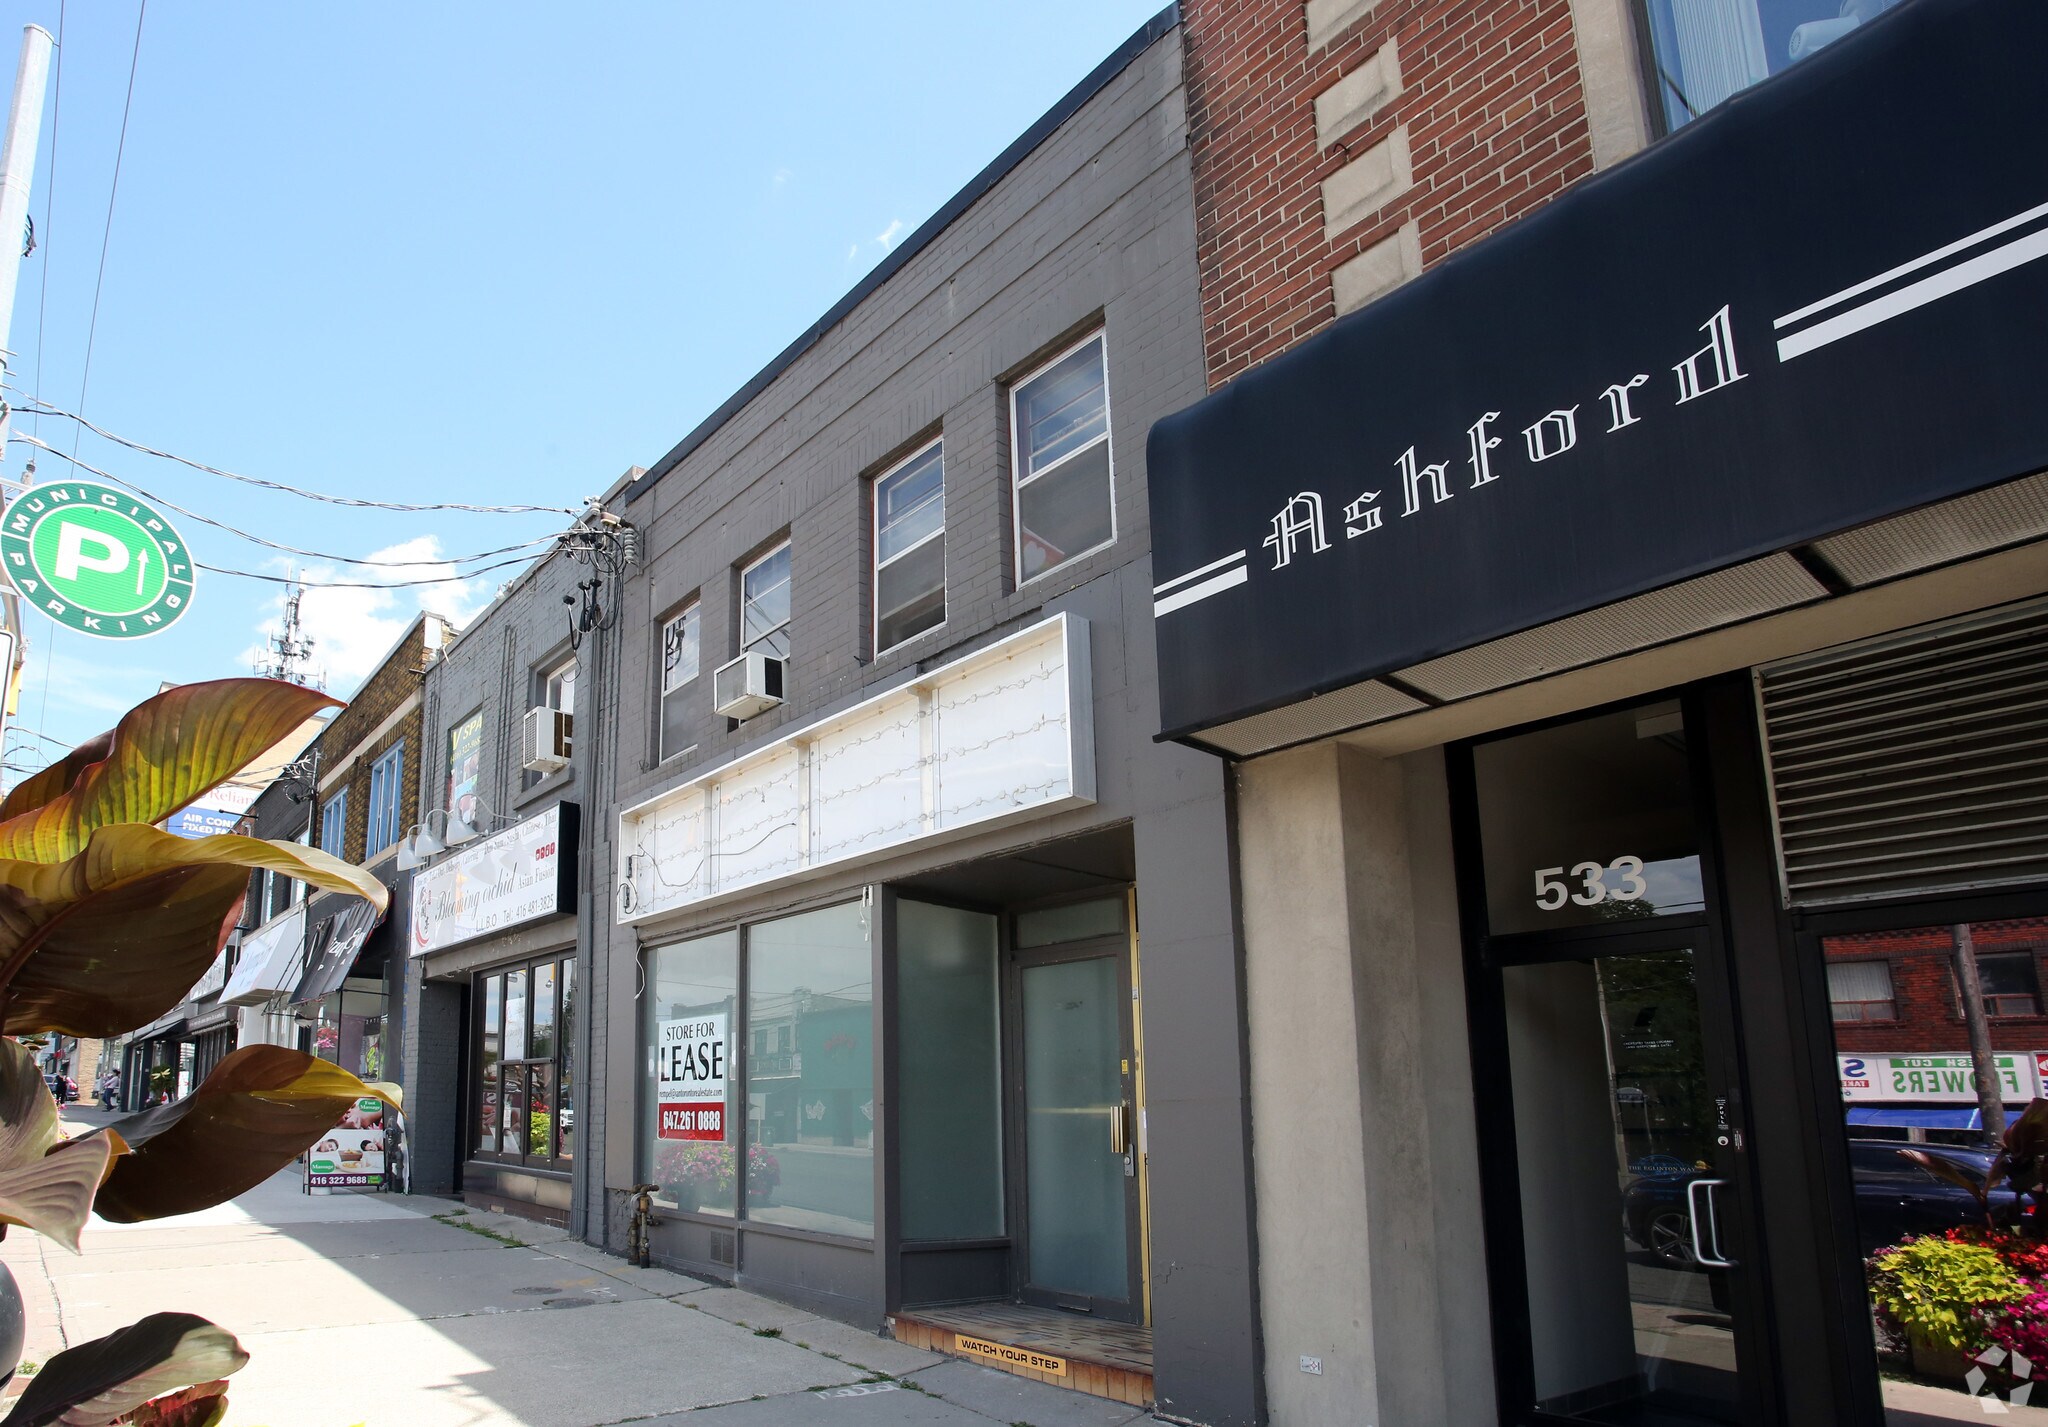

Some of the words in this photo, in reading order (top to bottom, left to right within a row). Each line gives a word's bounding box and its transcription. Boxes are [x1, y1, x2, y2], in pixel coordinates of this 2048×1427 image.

[1262, 303, 1748, 571] Ashford
[11, 488, 185, 575] MUNICIPAL
[54, 520, 130, 582] P
[10, 552, 182, 632] PARKING
[182, 822, 213, 833] FIXED
[183, 813, 203, 823] AIR
[435, 888, 480, 922] Blooming
[482, 861, 518, 903] orchid
[518, 873, 534, 890] Asian
[535, 866, 555, 885] Fusion
[1535, 855, 1647, 911] 533
[516, 904, 526, 918] 416
[666, 1024, 693, 1041] STORE
[696, 1021, 715, 1037] FOR
[661, 1042, 723, 1082] LEASE
[663, 1111, 695, 1130] 647.261
[698, 1111, 720, 1131] 0888
[329, 1176, 344, 1184] 322
[346, 1176, 367, 1184] 9688
[961, 1339, 997, 1356] WATCH
[999, 1348, 1028, 1364] YOUR
[1031, 1356, 1059, 1370] STEP
